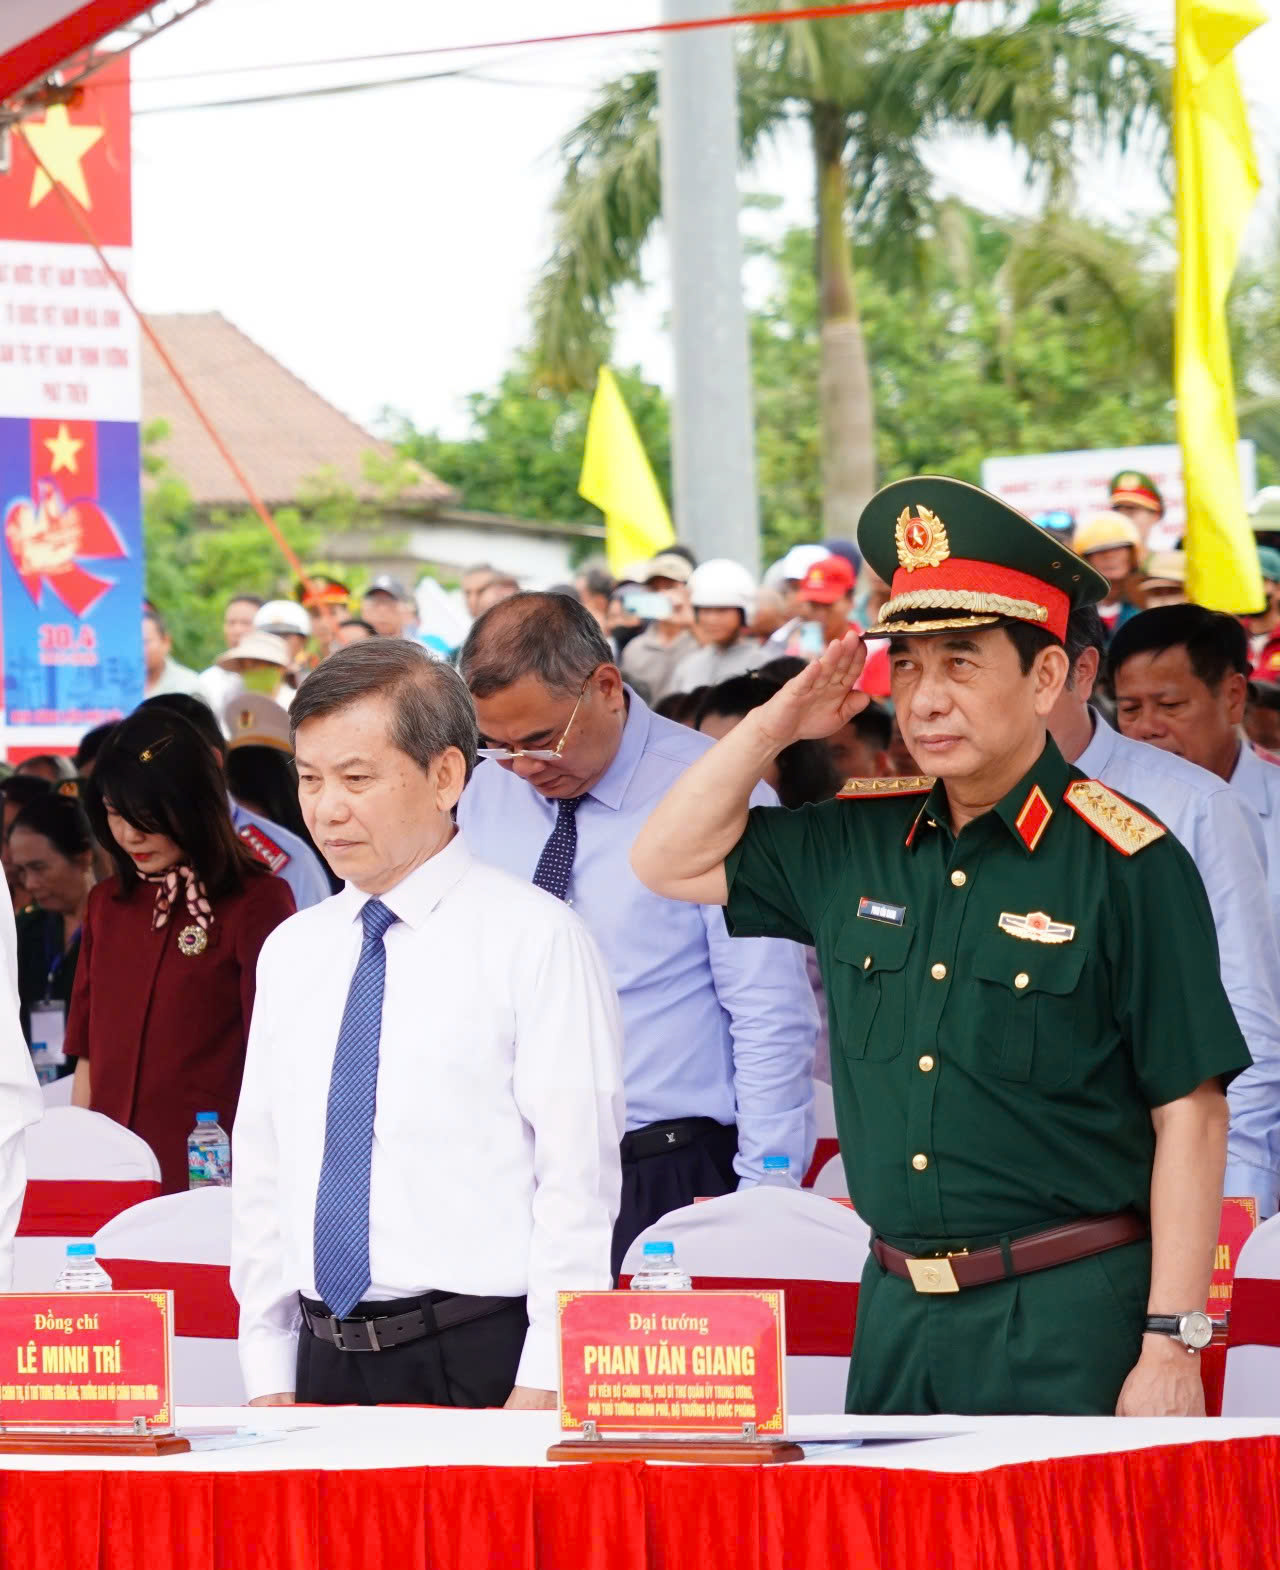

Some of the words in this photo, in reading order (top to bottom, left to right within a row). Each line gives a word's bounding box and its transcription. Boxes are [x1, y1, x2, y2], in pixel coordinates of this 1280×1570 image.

[35, 1308, 73, 1334] Đồng
[76, 1313, 99, 1330] chí
[629, 1313, 657, 1334] Đại
[661, 1313, 709, 1334] tướng
[17, 1340, 37, 1373] LÊ
[42, 1346, 89, 1373] MINH
[93, 1340, 121, 1373] TRÍ
[584, 1345, 639, 1375] PHAN
[645, 1340, 686, 1375] VĂN
[692, 1346, 755, 1375] GIANG
